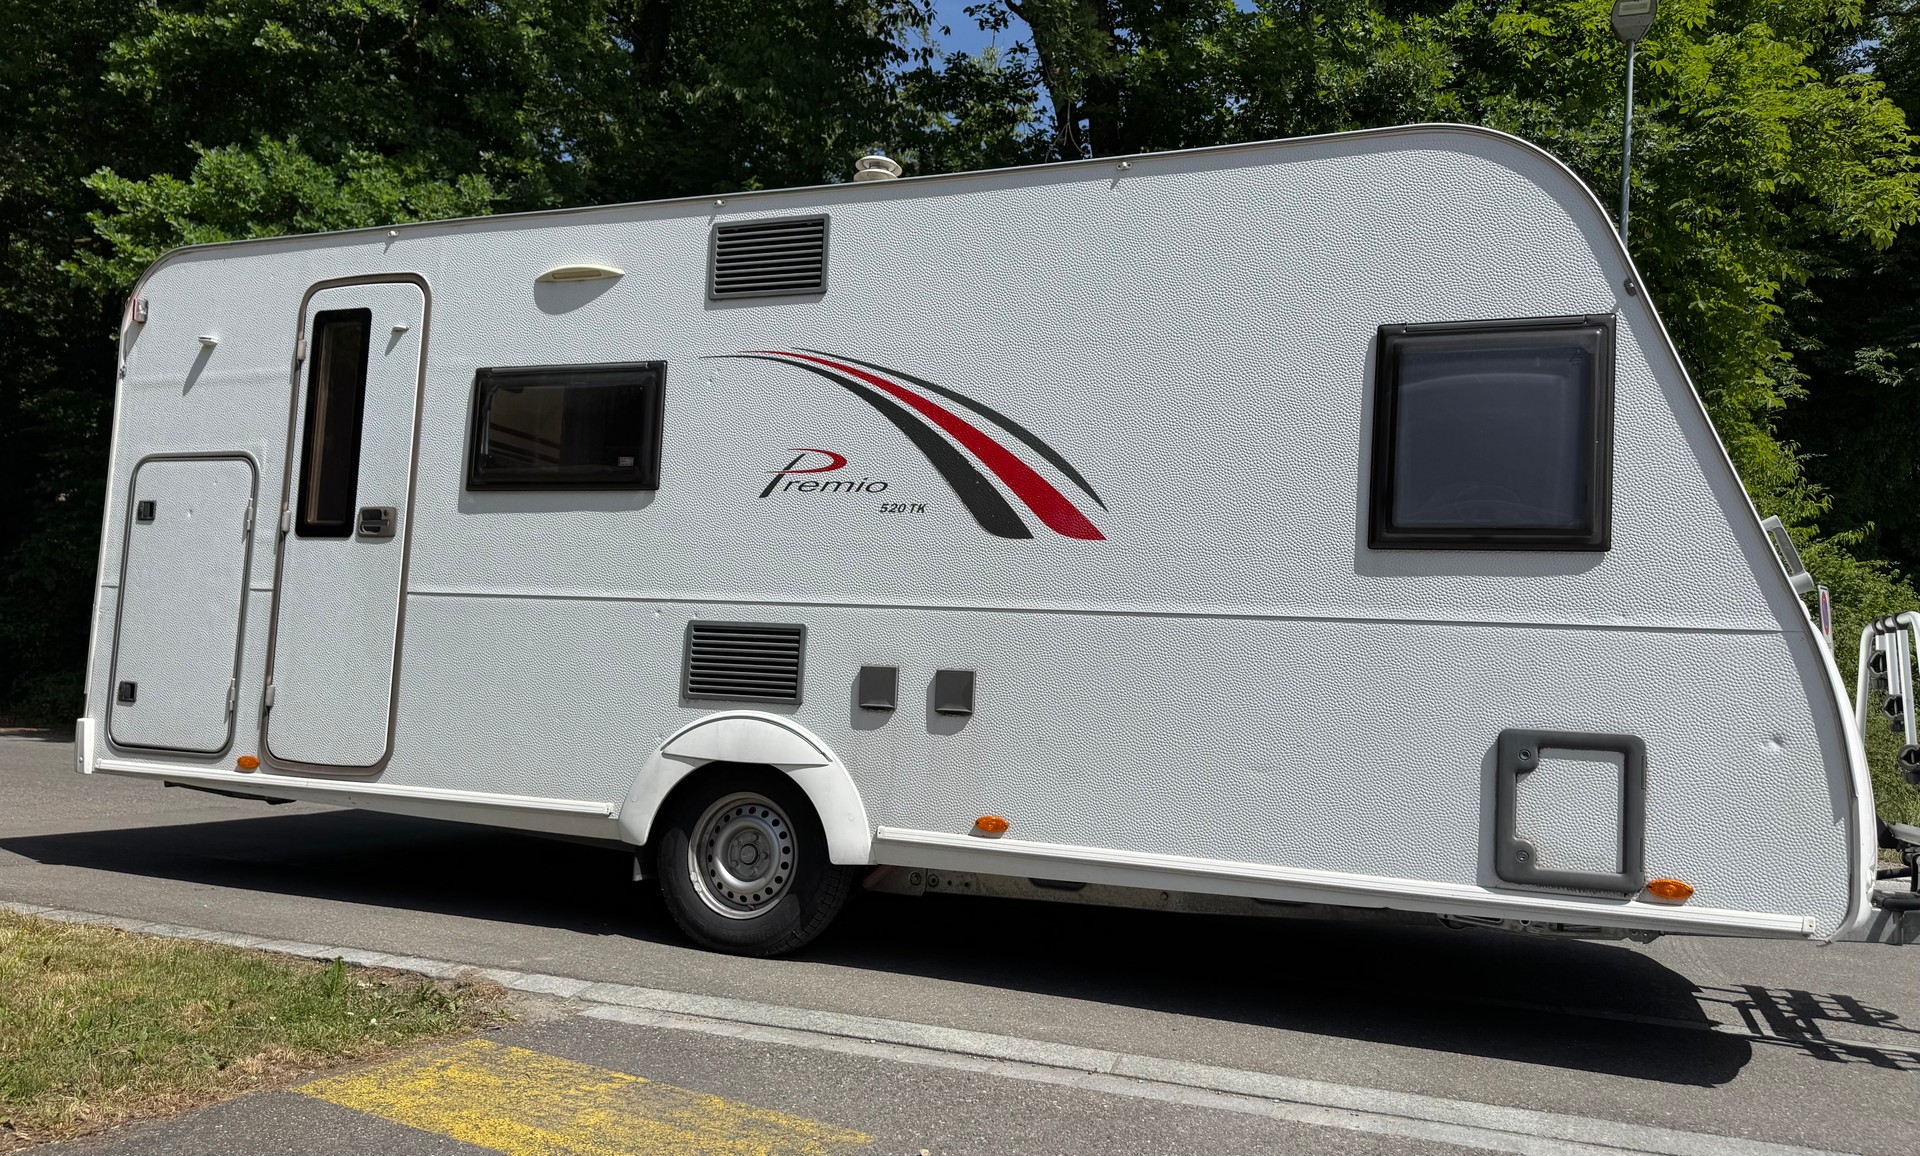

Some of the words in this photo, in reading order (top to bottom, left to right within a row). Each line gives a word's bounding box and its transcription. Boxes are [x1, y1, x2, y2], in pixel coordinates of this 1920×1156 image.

[758, 448, 889, 497] Premio
[879, 503, 907, 513] 520
[909, 503, 927, 513] TK
